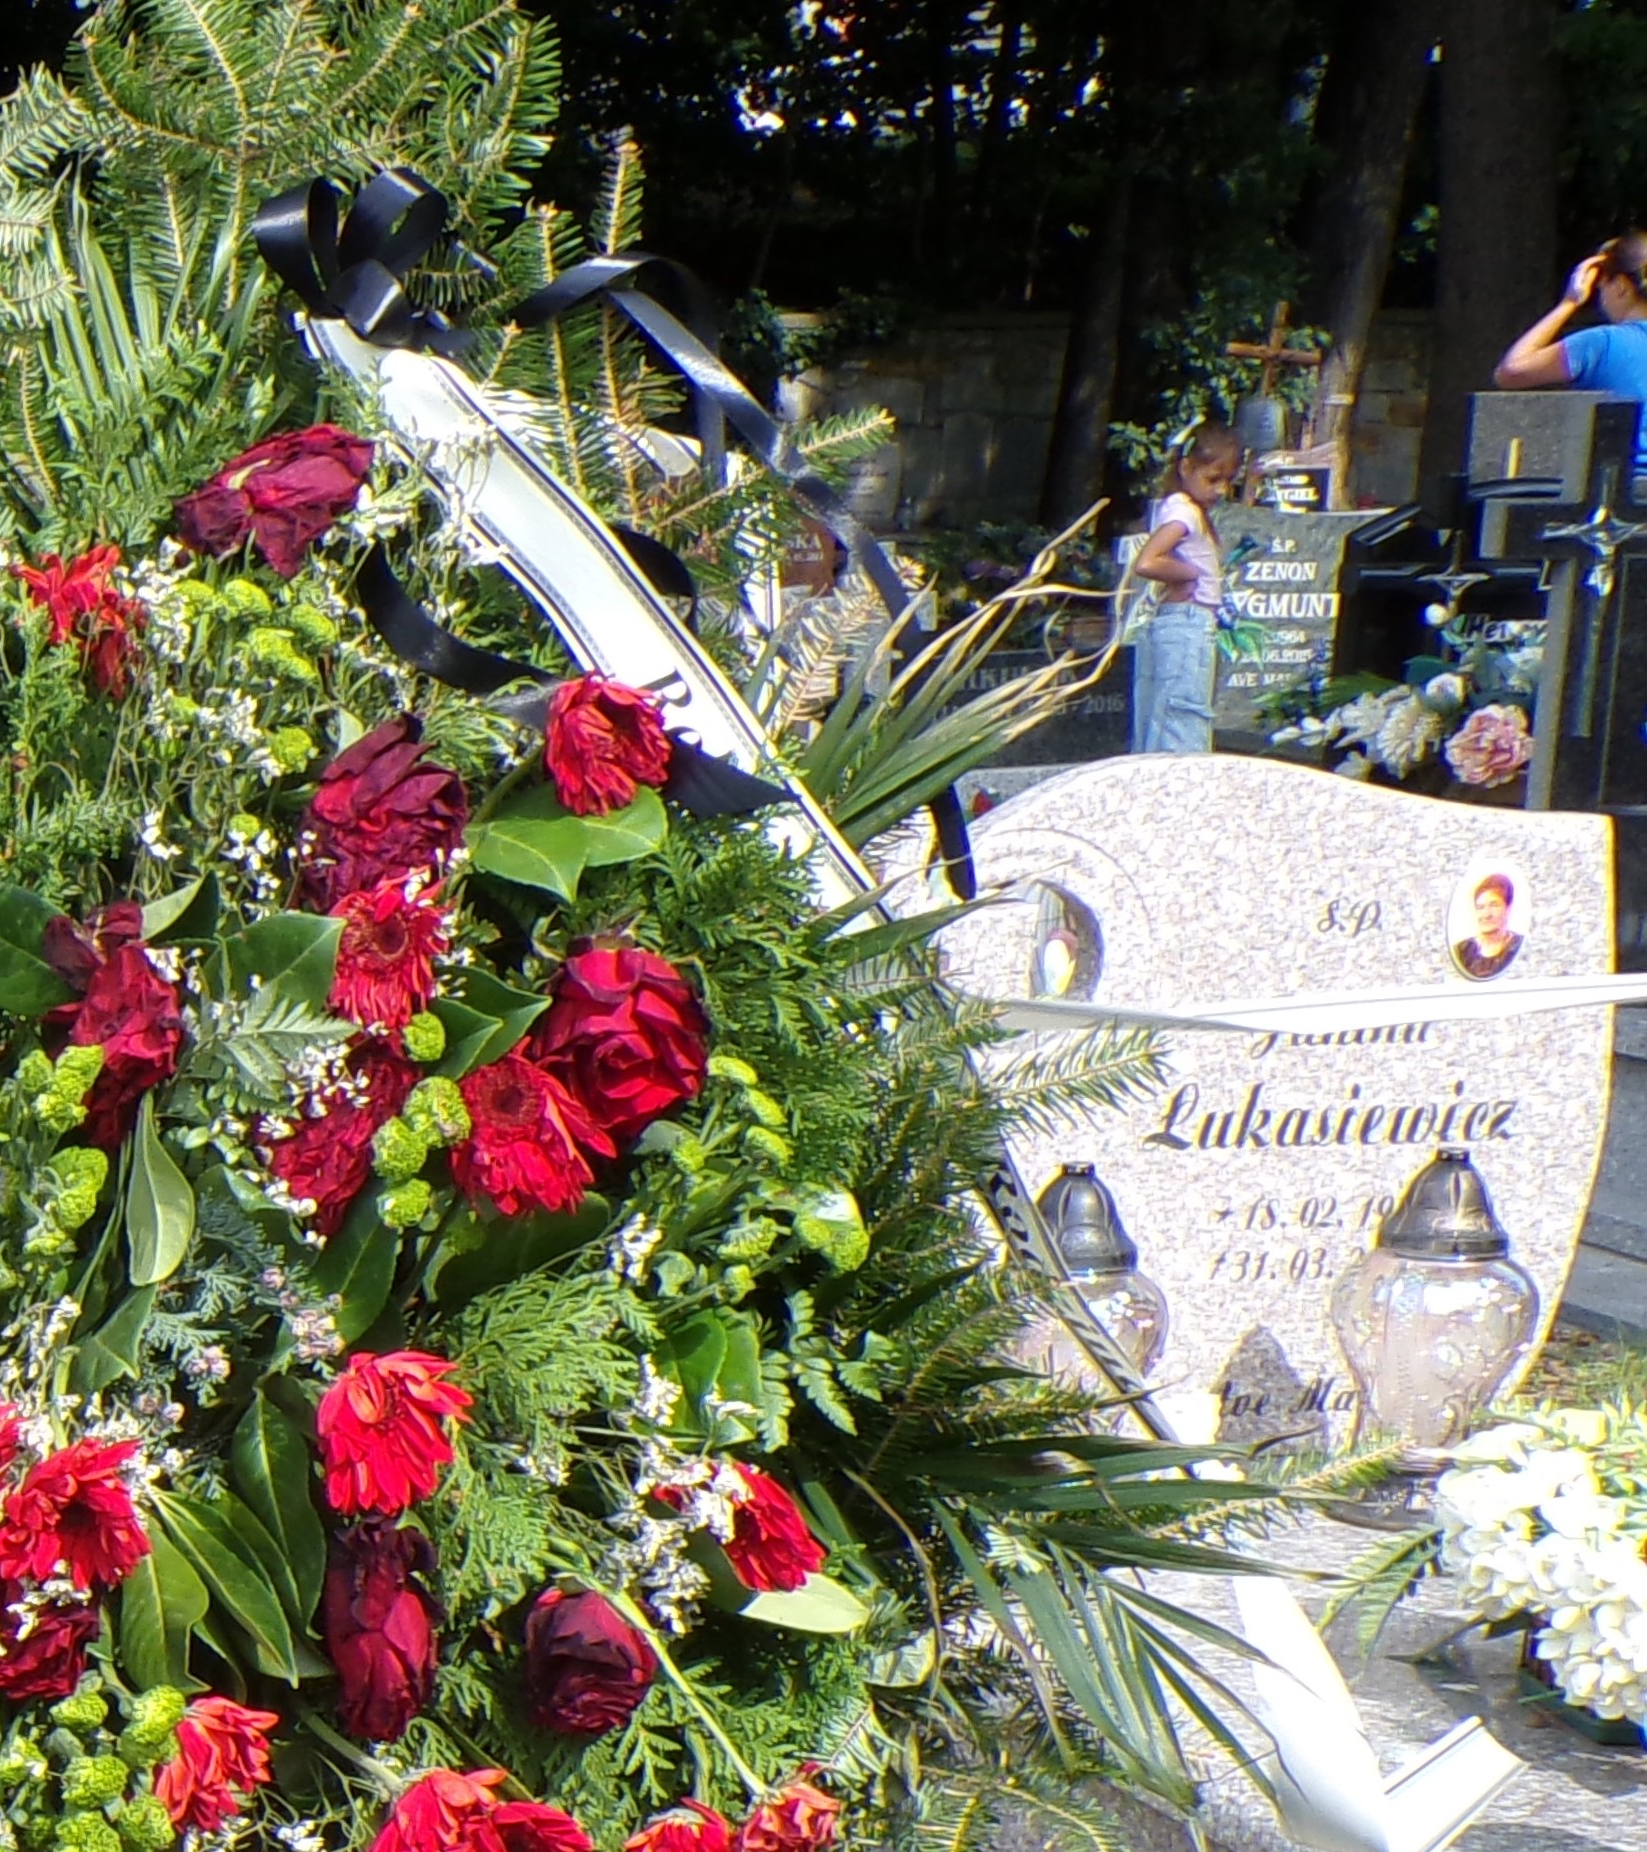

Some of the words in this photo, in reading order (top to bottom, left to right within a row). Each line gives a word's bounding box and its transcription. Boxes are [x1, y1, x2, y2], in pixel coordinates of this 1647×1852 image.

[1245, 561, 1317, 581] ZENON
[1221, 593, 1341, 618] YGMUNT
[1226, 672, 1258, 687] AVE
